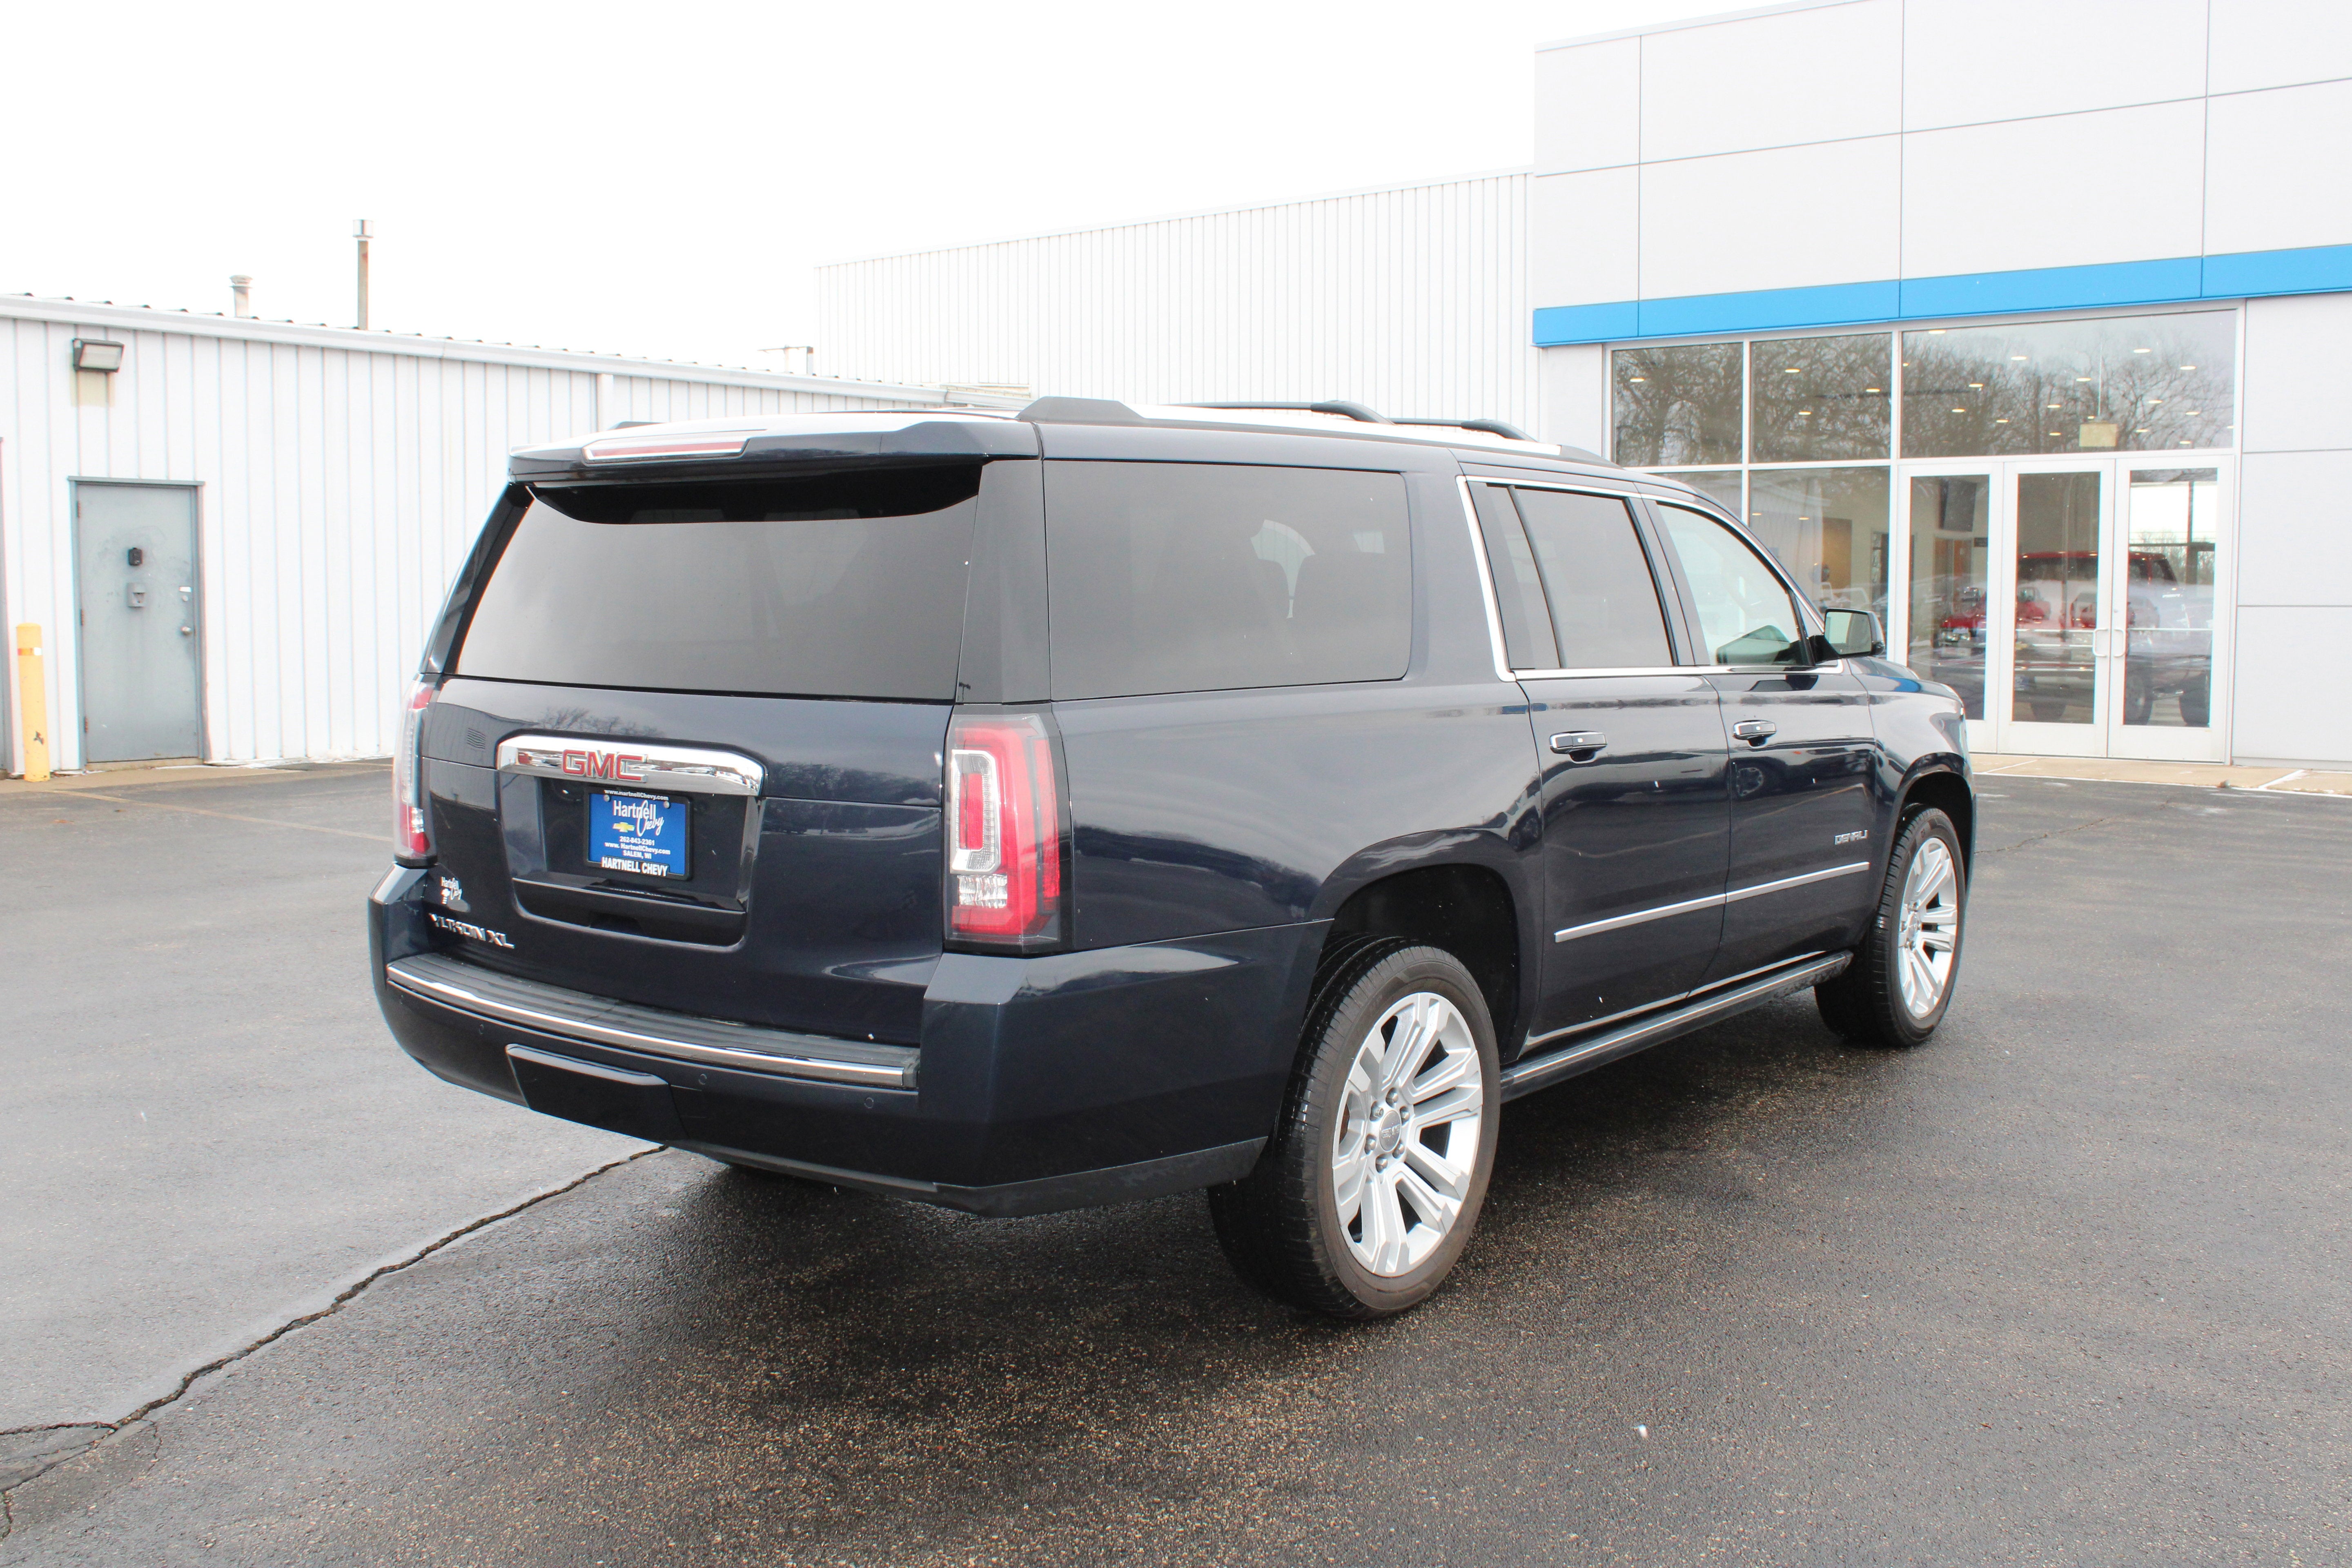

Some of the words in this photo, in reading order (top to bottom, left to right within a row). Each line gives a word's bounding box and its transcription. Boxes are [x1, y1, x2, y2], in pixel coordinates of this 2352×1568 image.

[561, 749, 648, 783] GMC
[613, 800, 657, 820] Hartnell
[636, 800, 664, 837] Chevy
[619, 836, 655, 846] 262-843-2361
[620, 843, 671, 855] HartnellChevy.com
[623, 850, 644, 859] SALEM,
[601, 857, 641, 873] HARTNELL
[641, 862, 668, 877] CHEVY
[486, 929, 515, 949] XL
